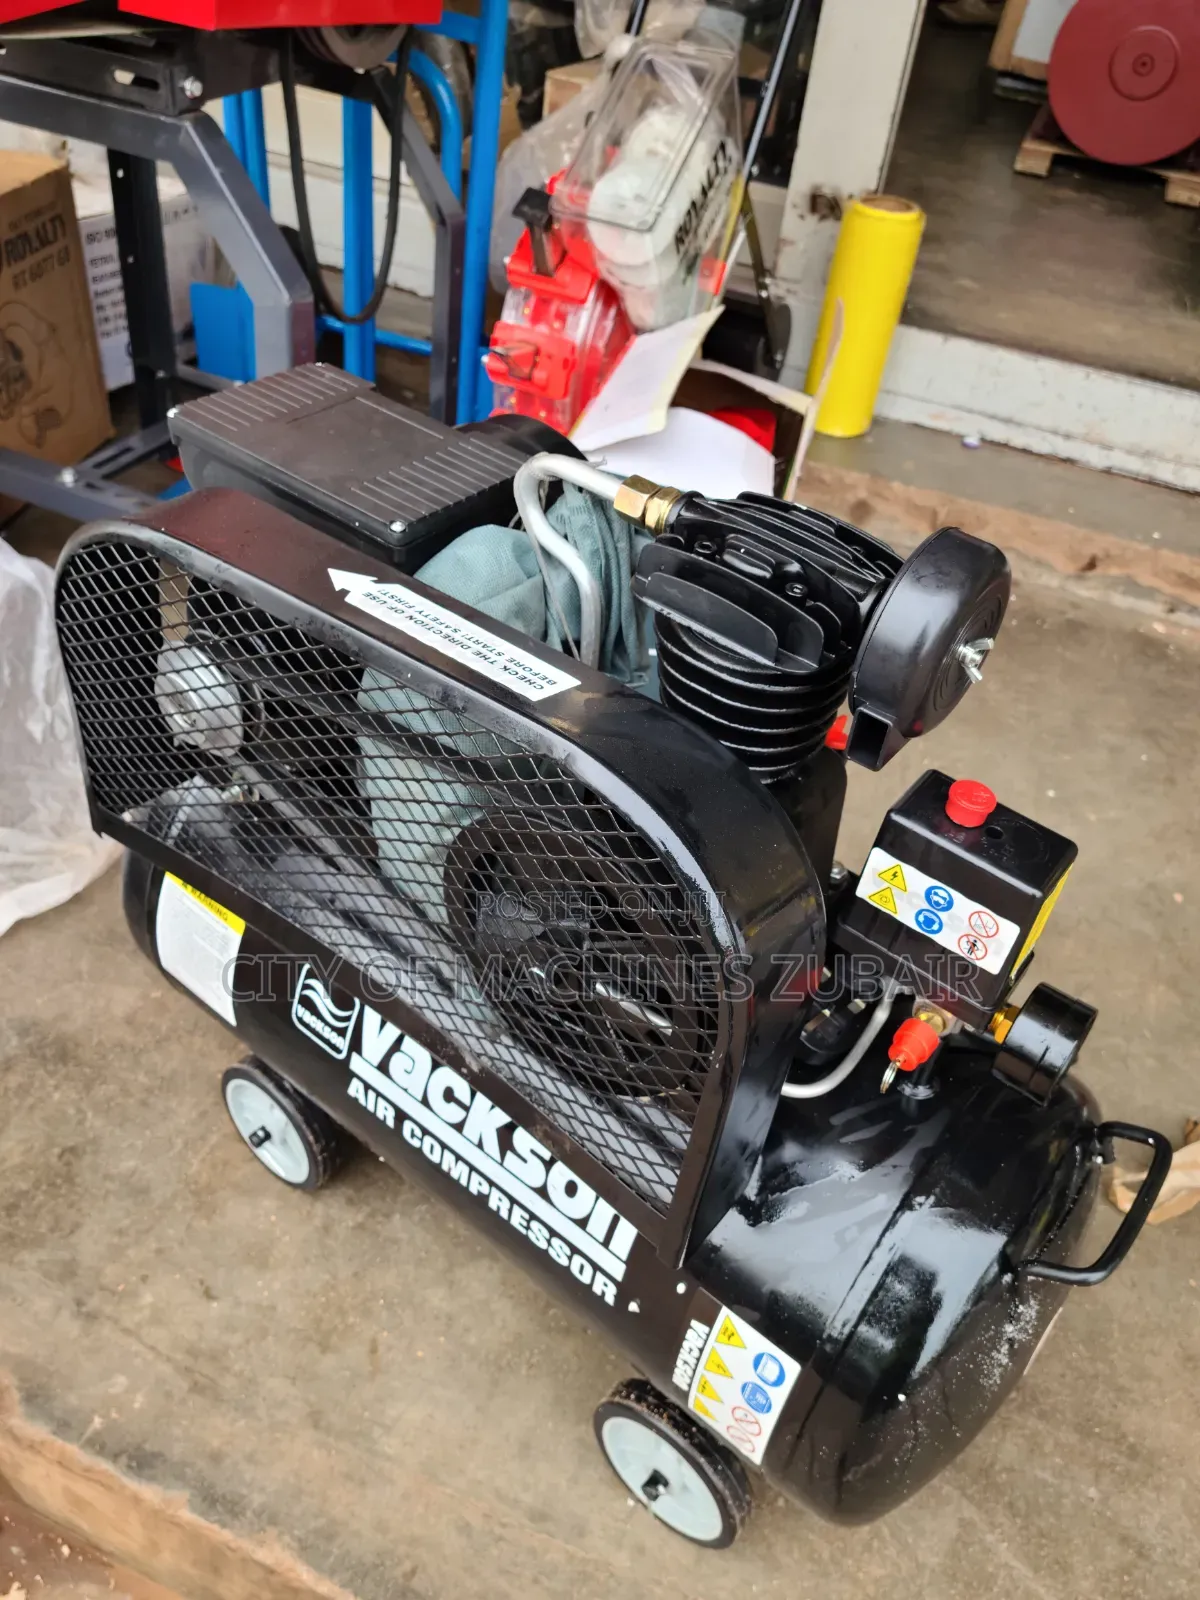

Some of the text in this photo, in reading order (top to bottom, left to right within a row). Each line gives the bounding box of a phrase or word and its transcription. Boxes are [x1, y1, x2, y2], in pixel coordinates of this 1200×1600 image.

[361, 591, 545, 691] CHECK THE DIRECTION OF USE
[376, 588, 558, 686] BEFORE START! SAFETY FIRST!
[347, 1077, 618, 1307] AIR COMPRESSOR
